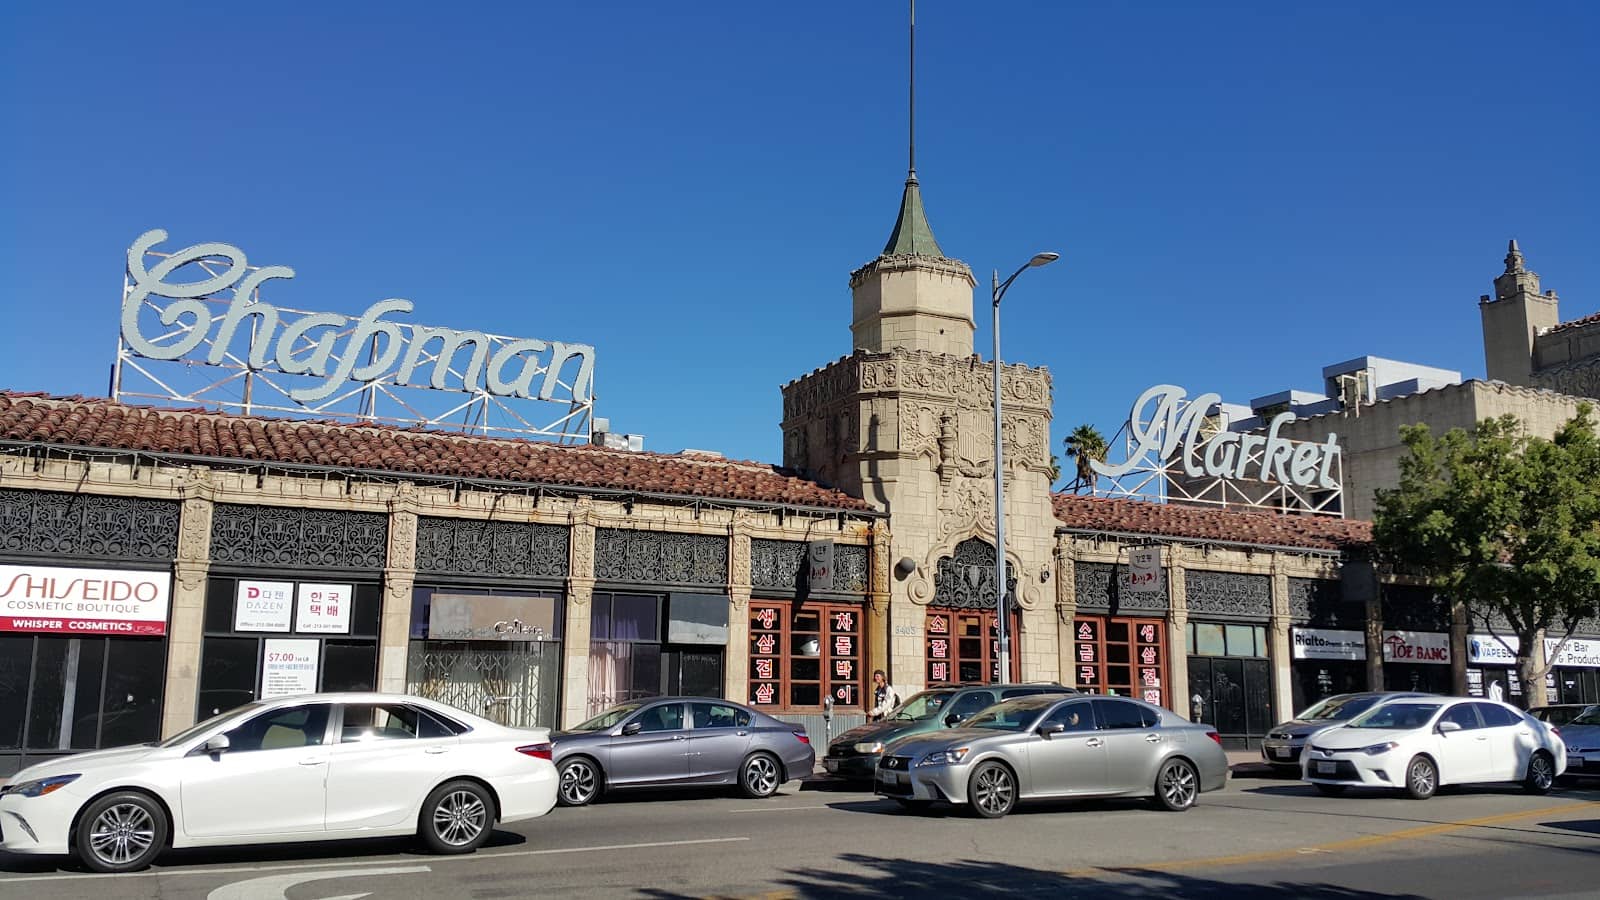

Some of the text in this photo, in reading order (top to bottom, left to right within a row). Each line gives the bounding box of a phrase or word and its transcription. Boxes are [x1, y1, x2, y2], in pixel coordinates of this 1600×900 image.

[120, 228, 595, 404] Chapman
[1089, 384, 1342, 488] Market
[0, 573, 159, 602] SHISEIDO
[7, 600, 140, 614] COSMETIC BOUTIQUE
[12, 619, 63, 630] WHISPER
[68, 621, 133, 632] COSMETICS
[930, 615, 948, 681] 소갈비
[1295, 635, 1325, 647] Rialto
[1574, 642, 1589, 652] Bar
[268, 653, 294, 662] $7.00
[756, 609, 776, 704] 생삼겹살
[835, 612, 853, 705] 차돌박이
[1416, 646, 1448, 660] BANG
